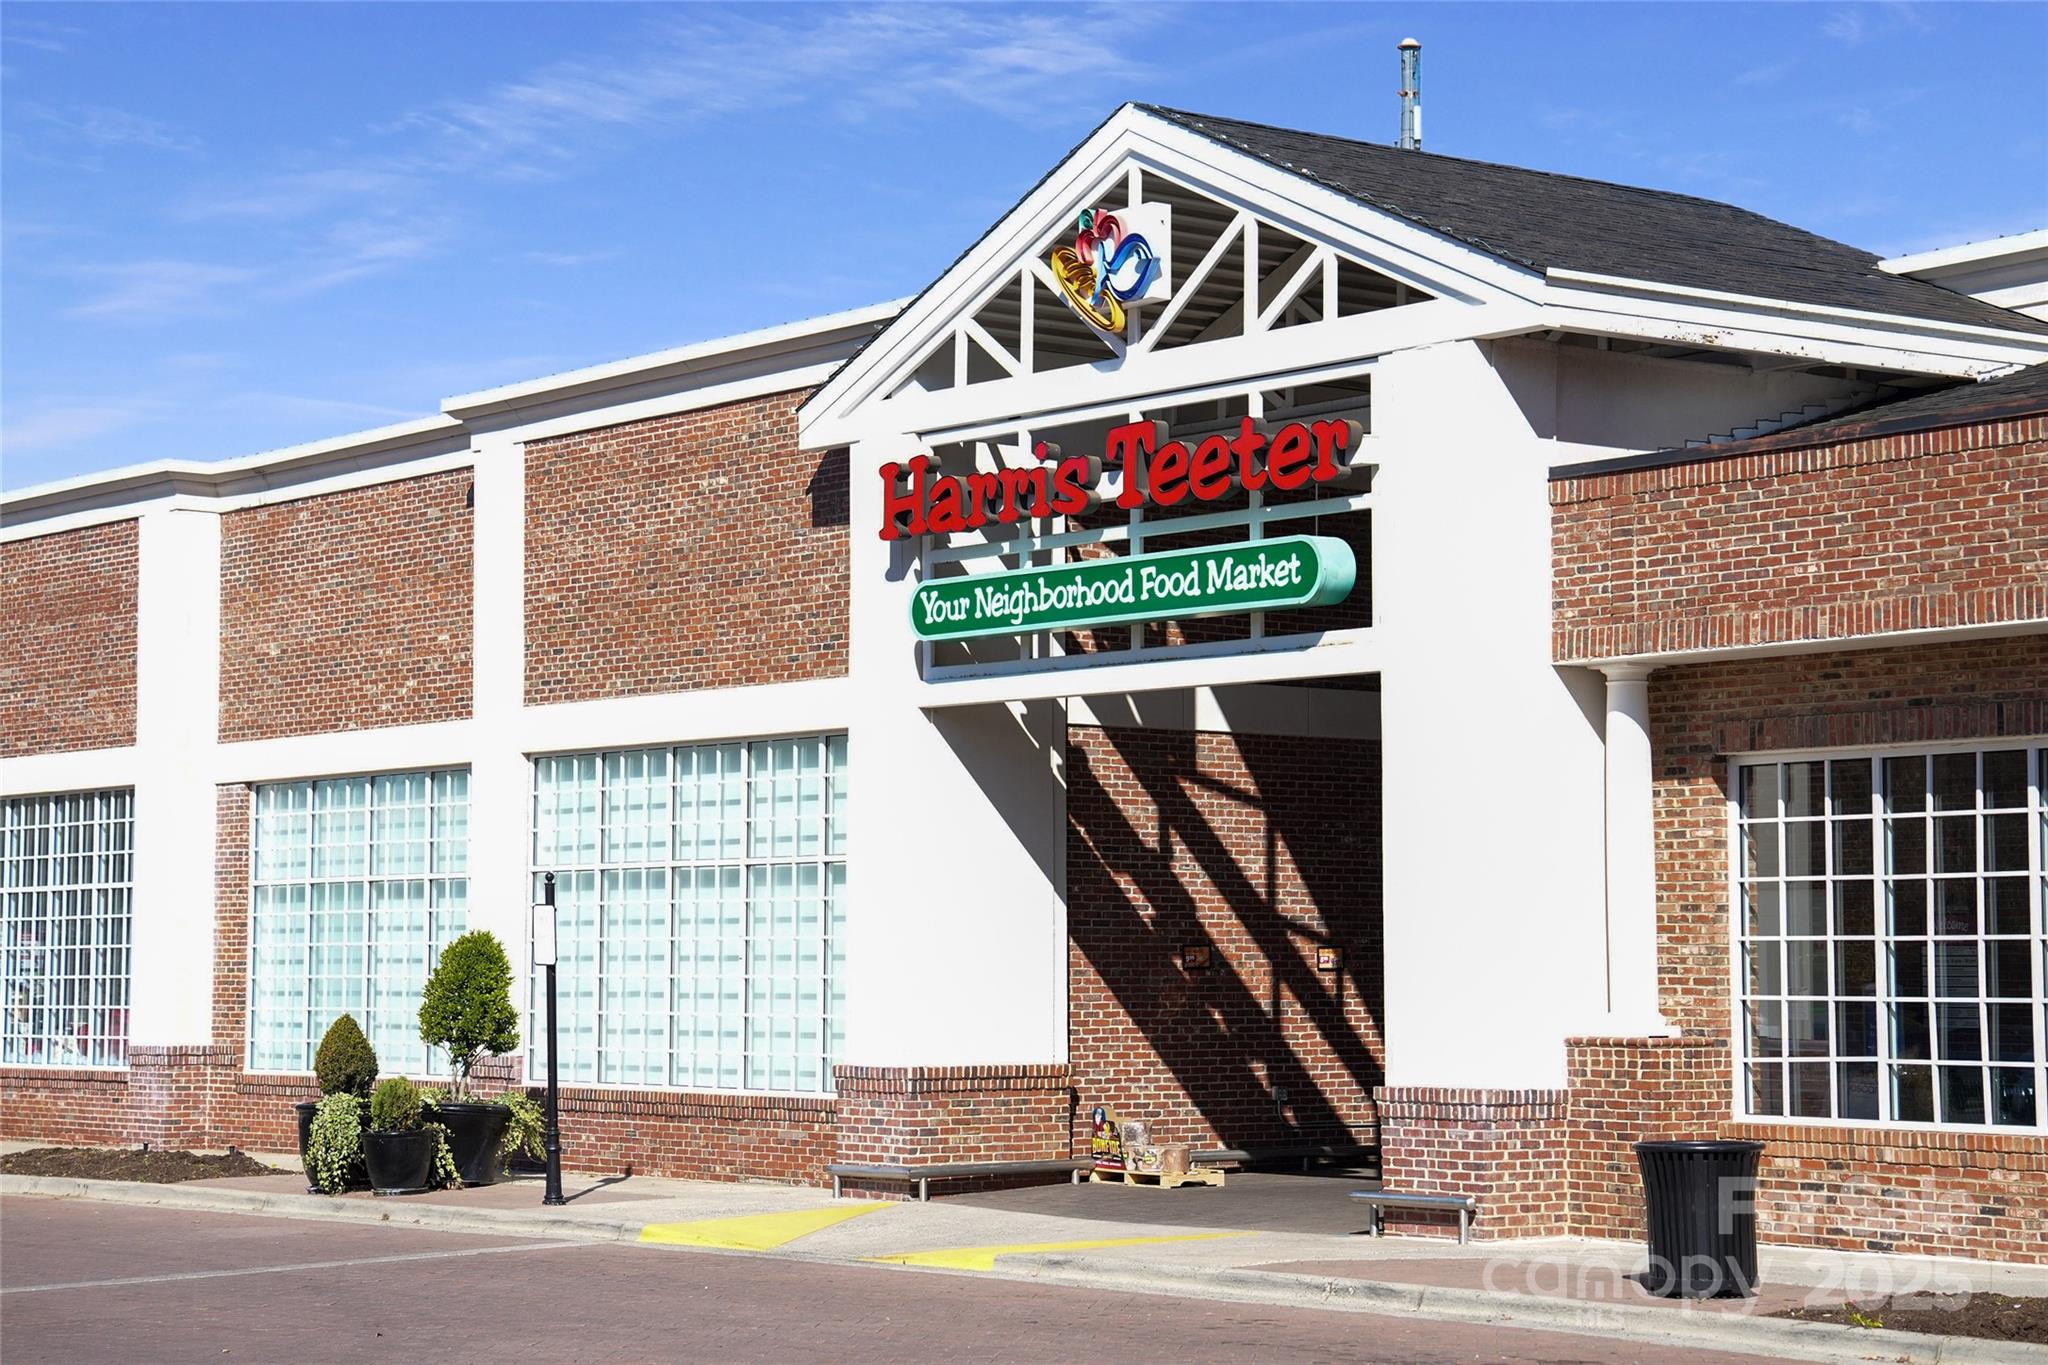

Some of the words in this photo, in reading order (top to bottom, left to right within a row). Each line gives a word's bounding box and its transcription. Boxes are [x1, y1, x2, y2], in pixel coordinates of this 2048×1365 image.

[878, 441, 1091, 541] Harris
[1105, 416, 1352, 510] Teeter
[919, 589, 970, 624] Your
[974, 568, 1135, 625] Neighborhood
[1140, 560, 1201, 601] Food
[1206, 552, 1302, 594] Market
